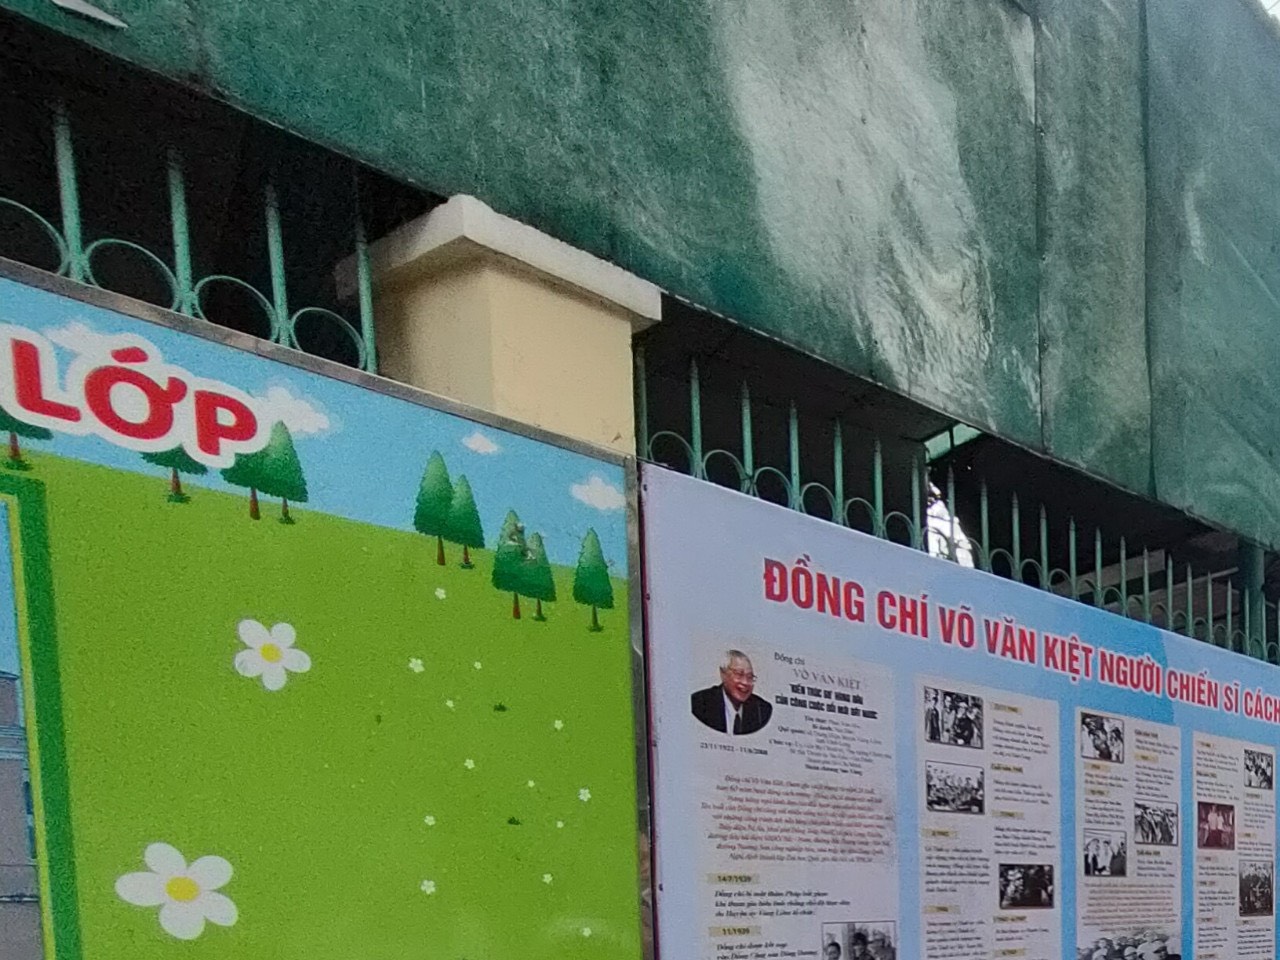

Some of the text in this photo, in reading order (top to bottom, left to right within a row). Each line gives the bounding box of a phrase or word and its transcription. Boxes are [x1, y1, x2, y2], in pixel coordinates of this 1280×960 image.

[11, 338, 258, 455] LỚP
[763, 554, 865, 623] ĐỒNG
[877, 594, 929, 638] CHÍ
[938, 605, 975, 648] VÕ
[984, 617, 1036, 664] VĂN
[1044, 635, 1093, 683] KIỆT
[1099, 647, 1162, 695] NGƯỜI
[1167, 671, 1219, 708] CHIẾN
[1224, 682, 1239, 713] SĨ
